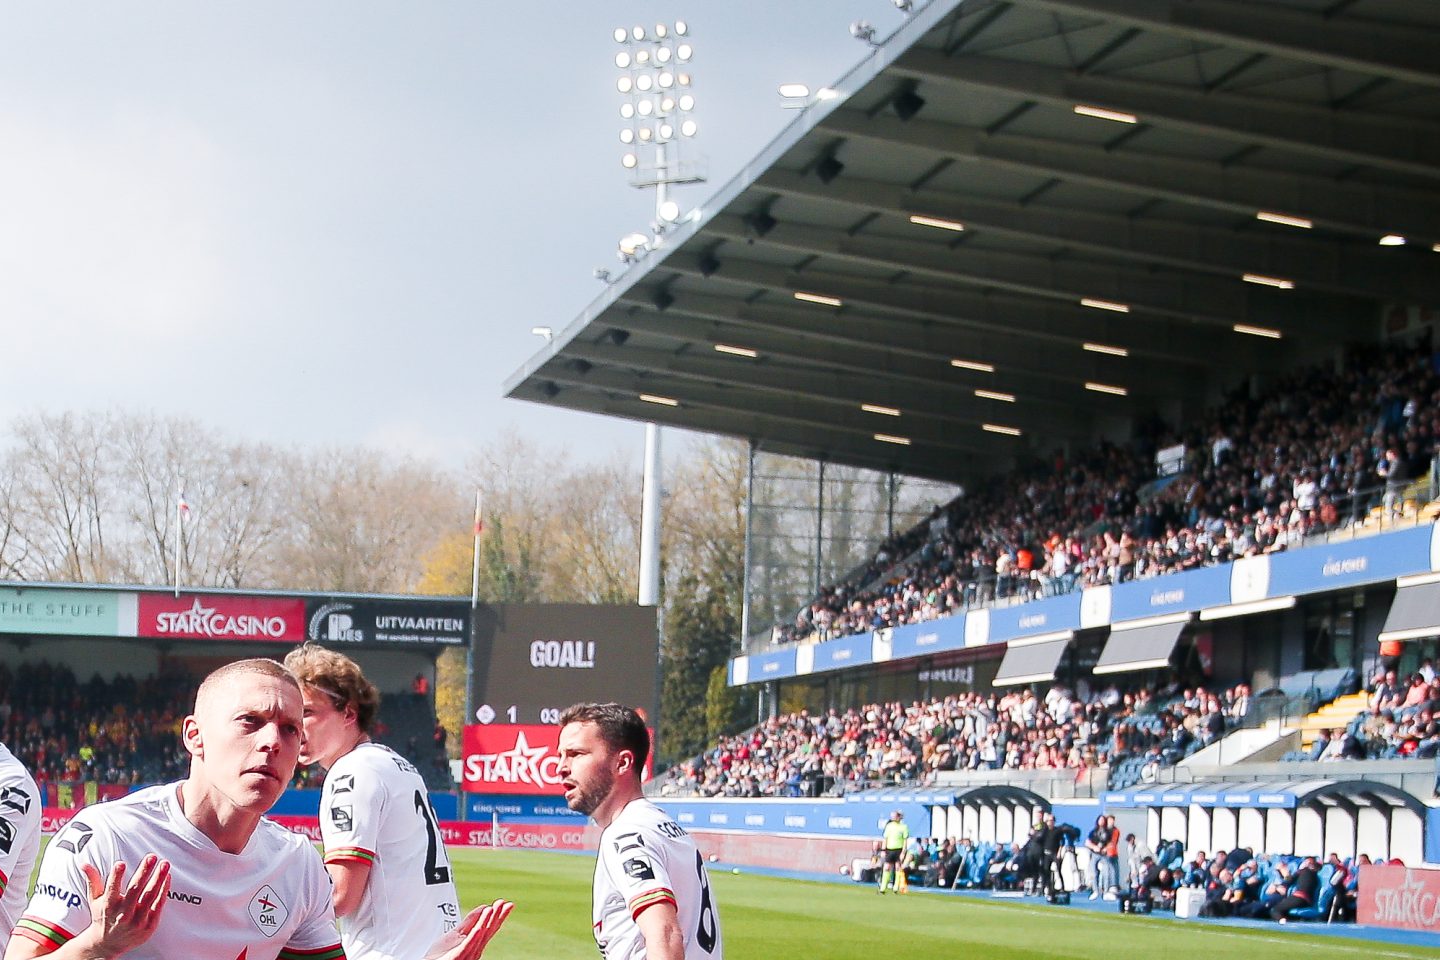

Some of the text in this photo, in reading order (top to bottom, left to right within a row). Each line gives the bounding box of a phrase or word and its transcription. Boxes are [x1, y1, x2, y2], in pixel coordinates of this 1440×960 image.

[0, 602, 106, 617] THE STUFF
[376, 616, 463, 631] UITVAARTEN
[530, 640, 595, 668] GOAL!
[507, 705, 517, 723] 1
[260, 914, 276, 925] OHL
